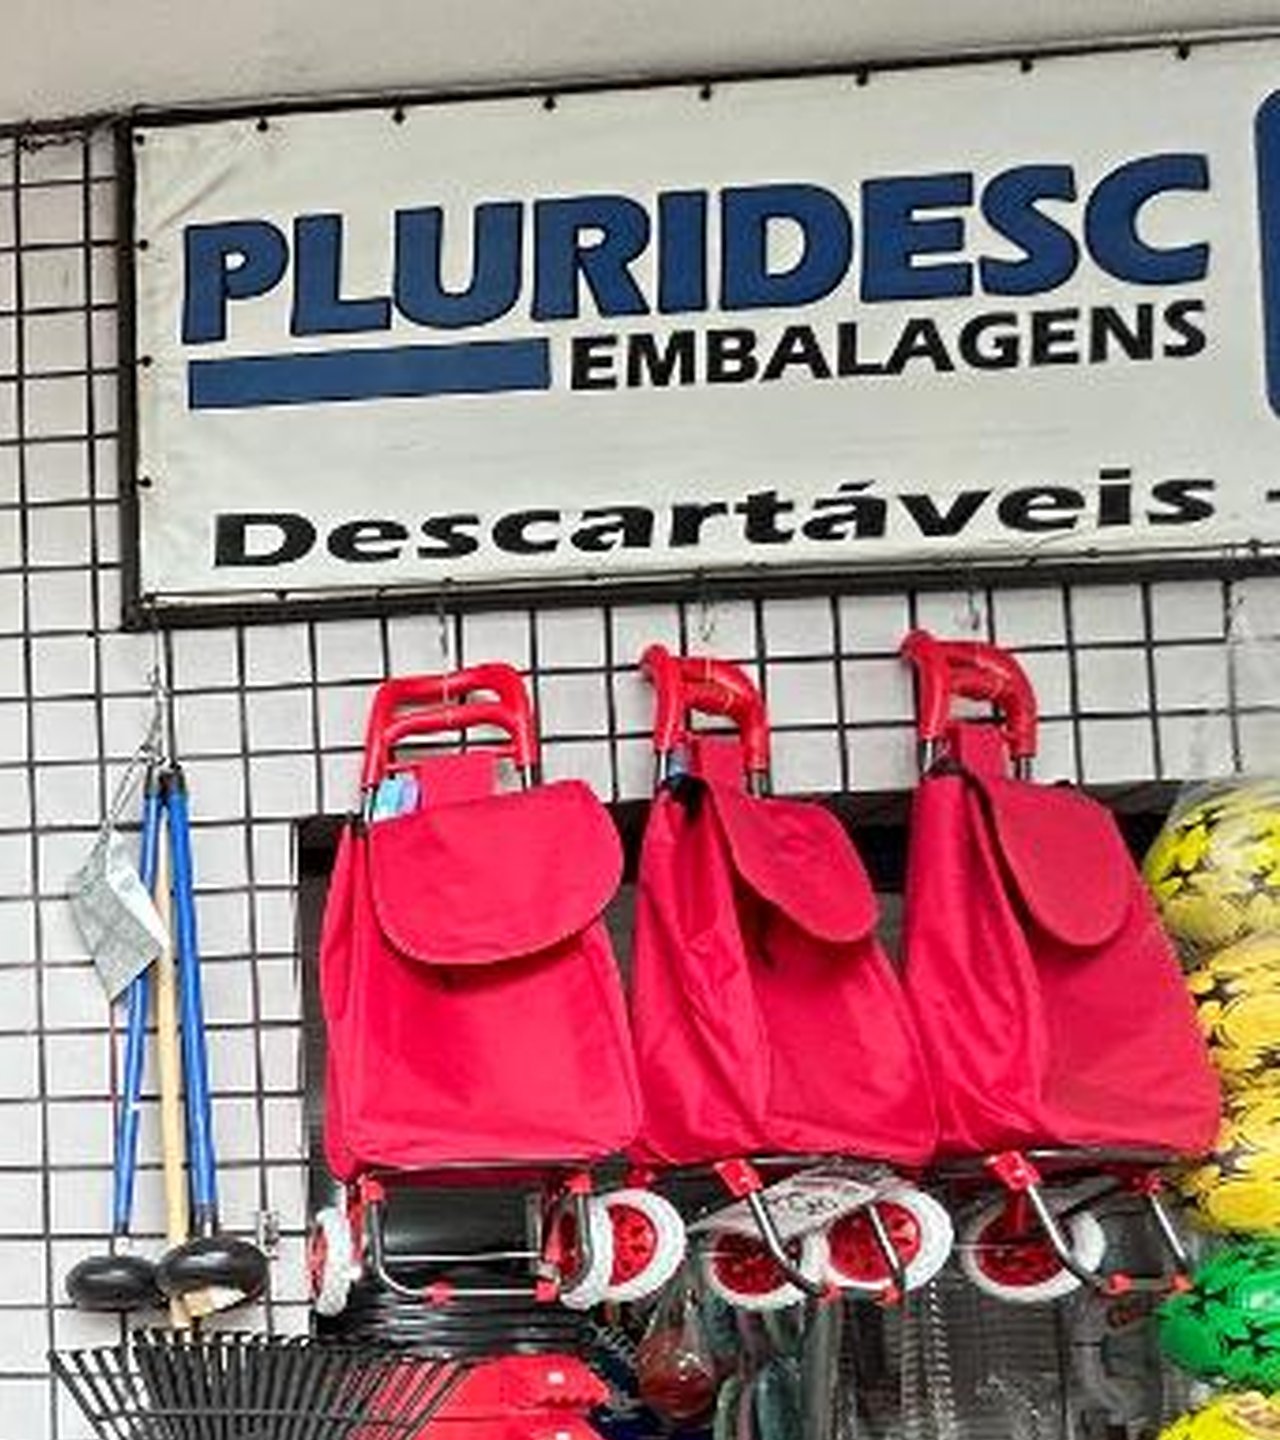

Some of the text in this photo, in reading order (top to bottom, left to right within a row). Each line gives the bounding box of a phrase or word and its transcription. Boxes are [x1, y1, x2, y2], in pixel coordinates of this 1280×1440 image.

[181, 153, 1210, 346] PLURIDESC
[568, 299, 1208, 392] EMBALAGENS
[212, 468, 1216, 569] Descartáveis
